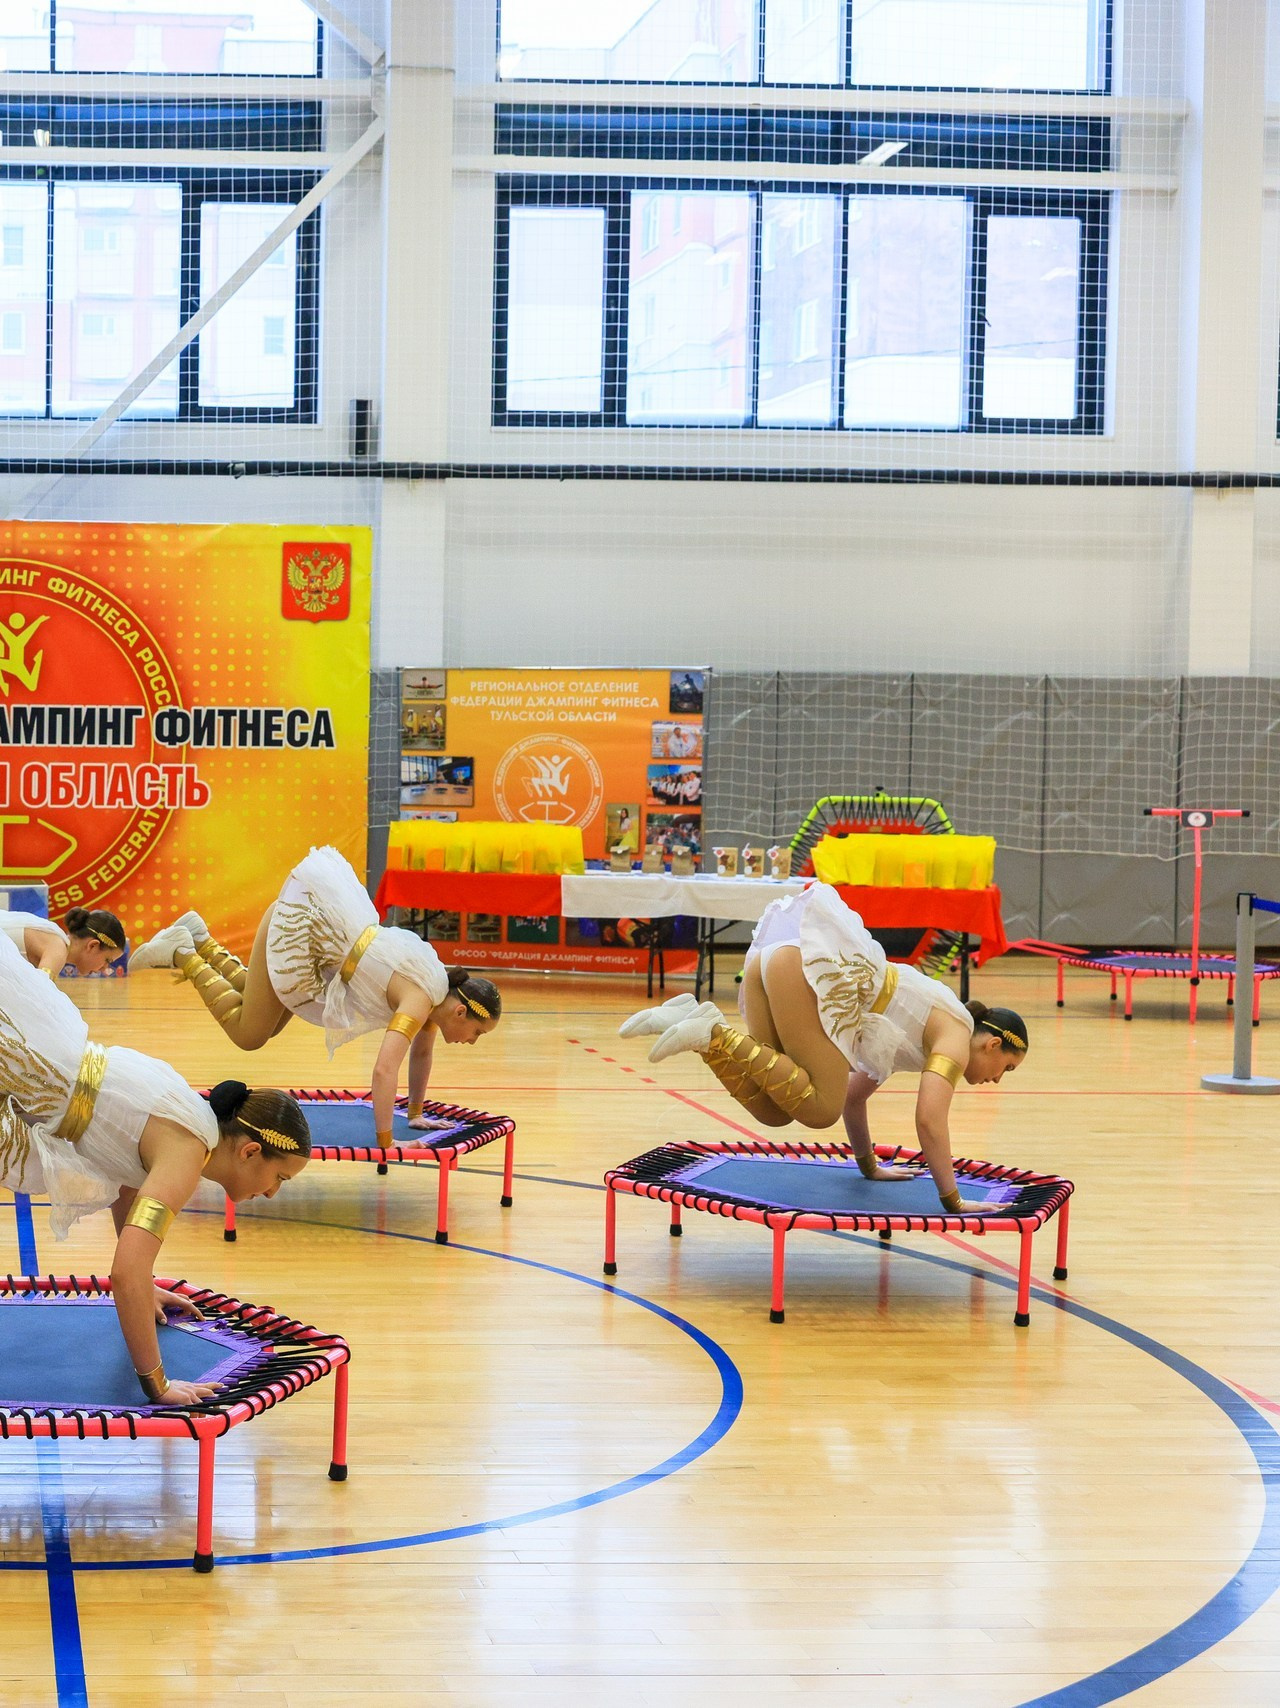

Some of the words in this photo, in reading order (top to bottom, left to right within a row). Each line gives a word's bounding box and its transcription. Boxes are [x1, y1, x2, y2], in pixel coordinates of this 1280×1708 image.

[47, 574, 141, 649] ФИТНЕСА
[470, 681, 565, 693] РЕГИОНАЛЬНОЕ
[568, 681, 639, 694] ОТДЕЛЕНИЕ
[450, 695, 522, 708] ФЕДЕРАЦИИ
[526, 696, 598, 708] ДЖАМПИНГ
[601, 697, 659, 708] ФИТНЕСА
[490, 709, 554, 721] ТУЛЬСКОЙ
[558, 711, 617, 722] ОБЛАСТИ
[154, 706, 336, 750] ФИТНЕСА
[20, 762, 212, 809] ОБЛАСТЬ
[453, 949, 487, 958] ОФСОО
[543, 953, 593, 963] ДЖАМПИНГ
